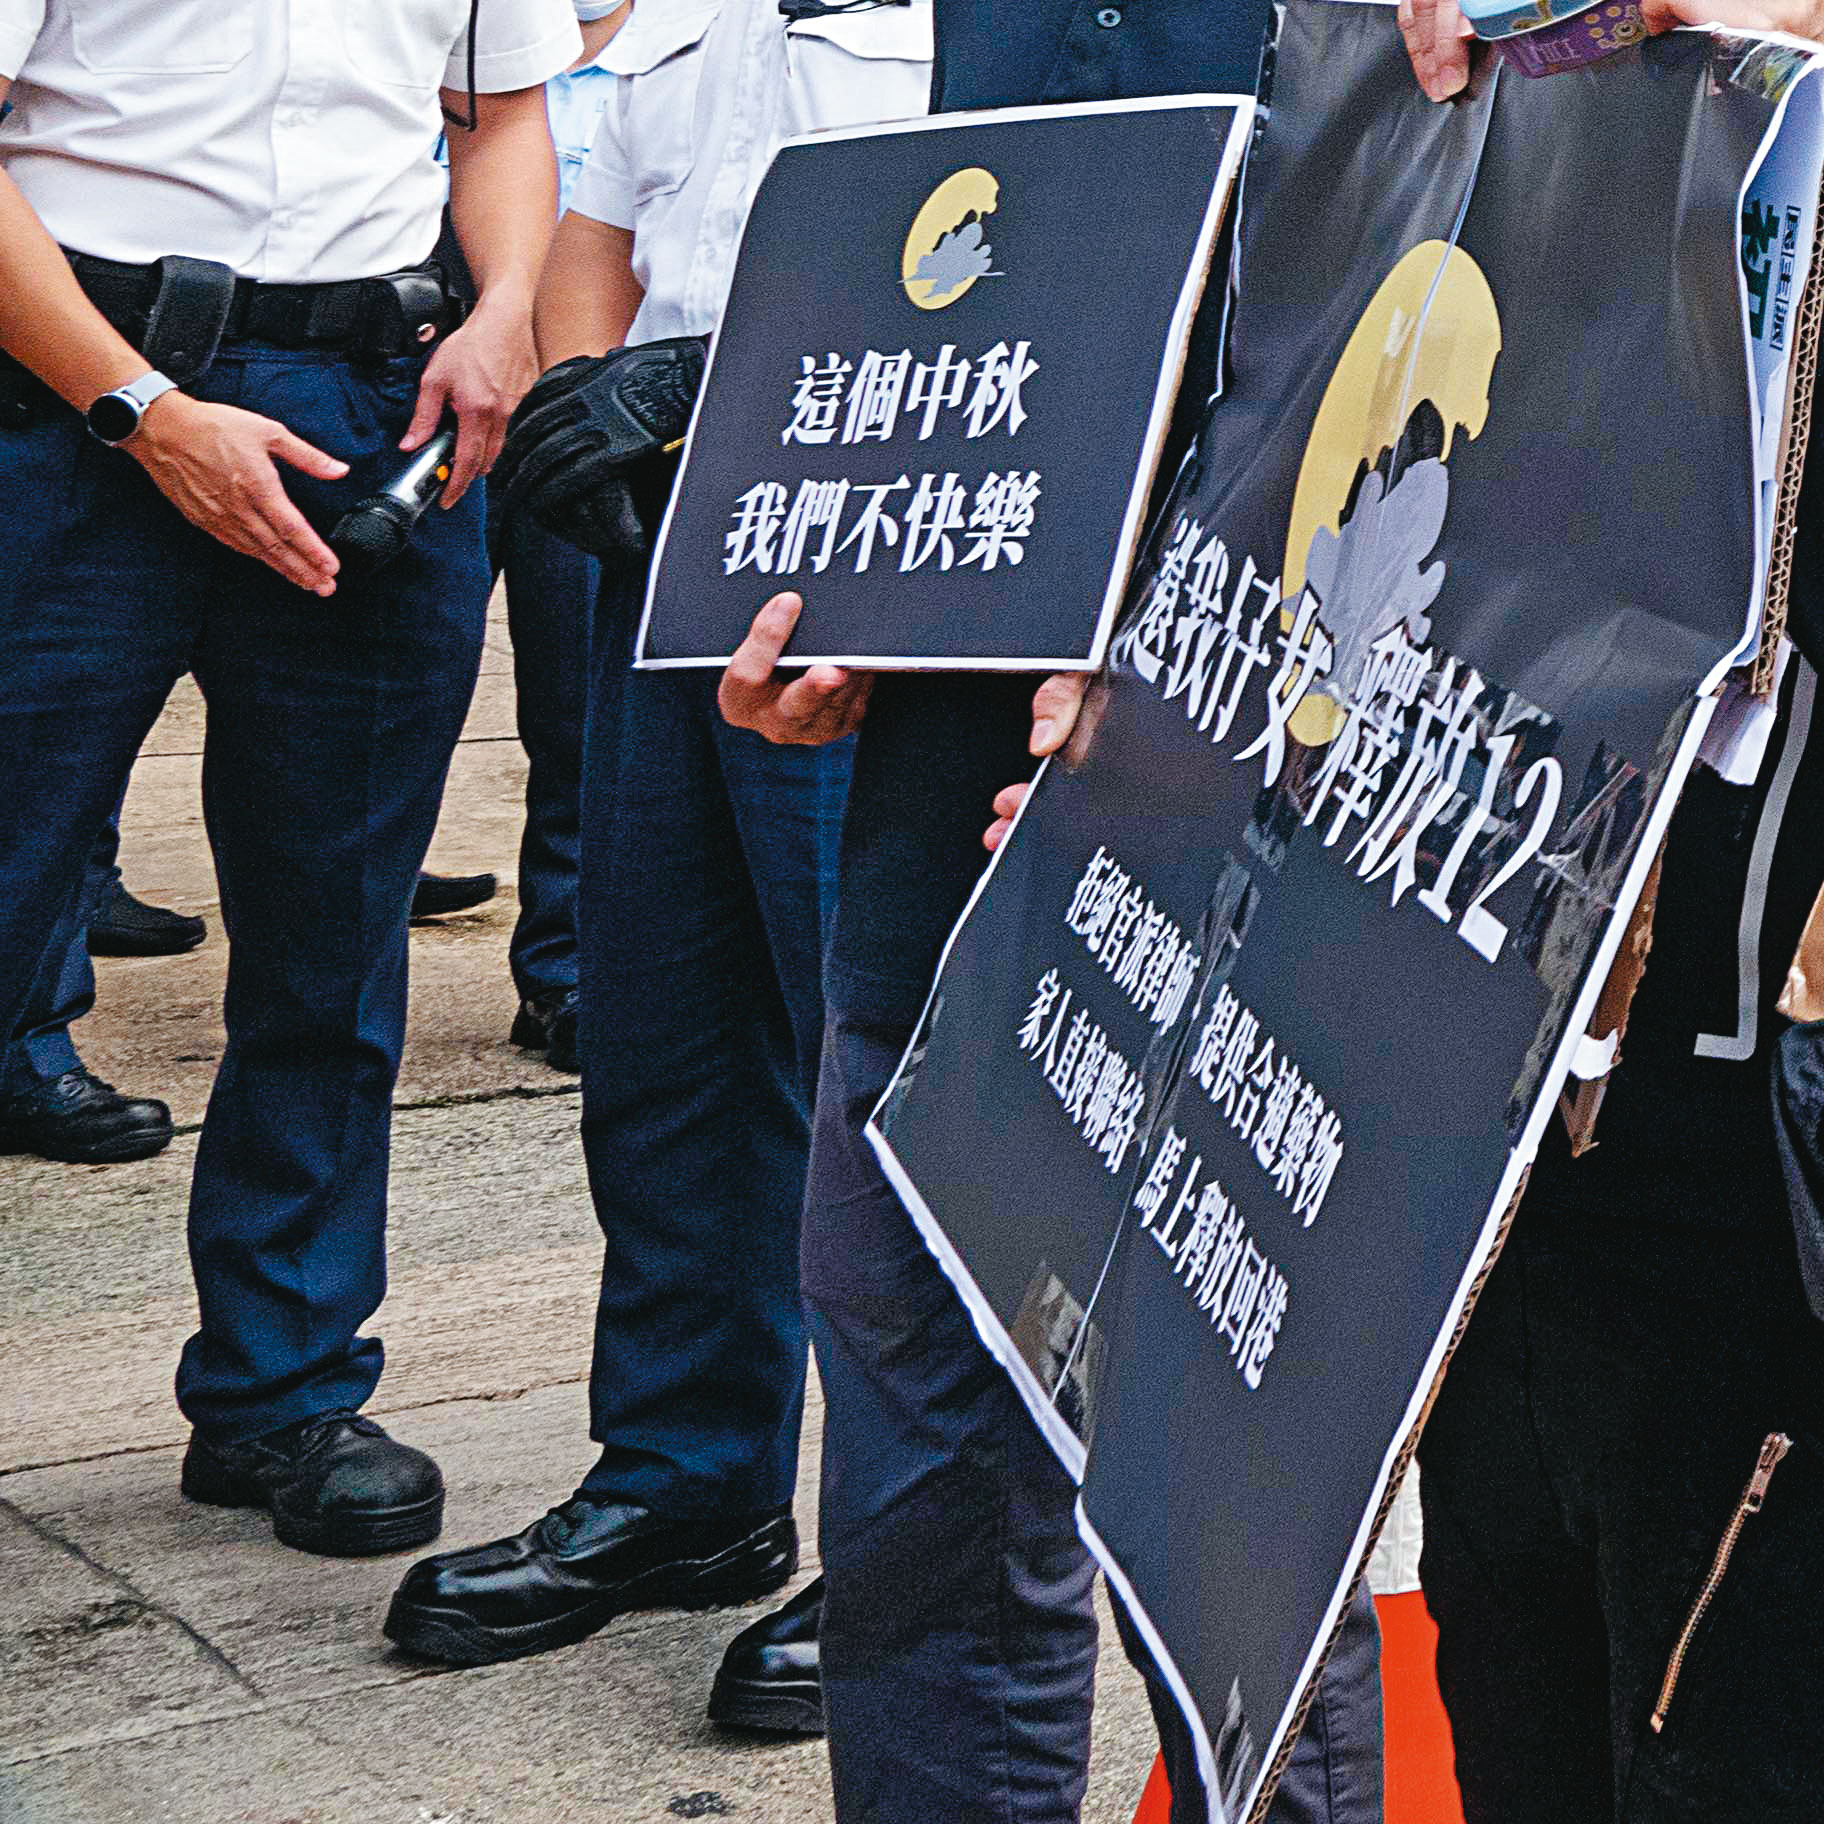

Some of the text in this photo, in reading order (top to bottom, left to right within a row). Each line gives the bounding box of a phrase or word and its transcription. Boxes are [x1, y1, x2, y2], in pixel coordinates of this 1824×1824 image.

[780, 339, 1041, 446] 這個中秋
[722, 470, 1043, 576] 我們不快樂
